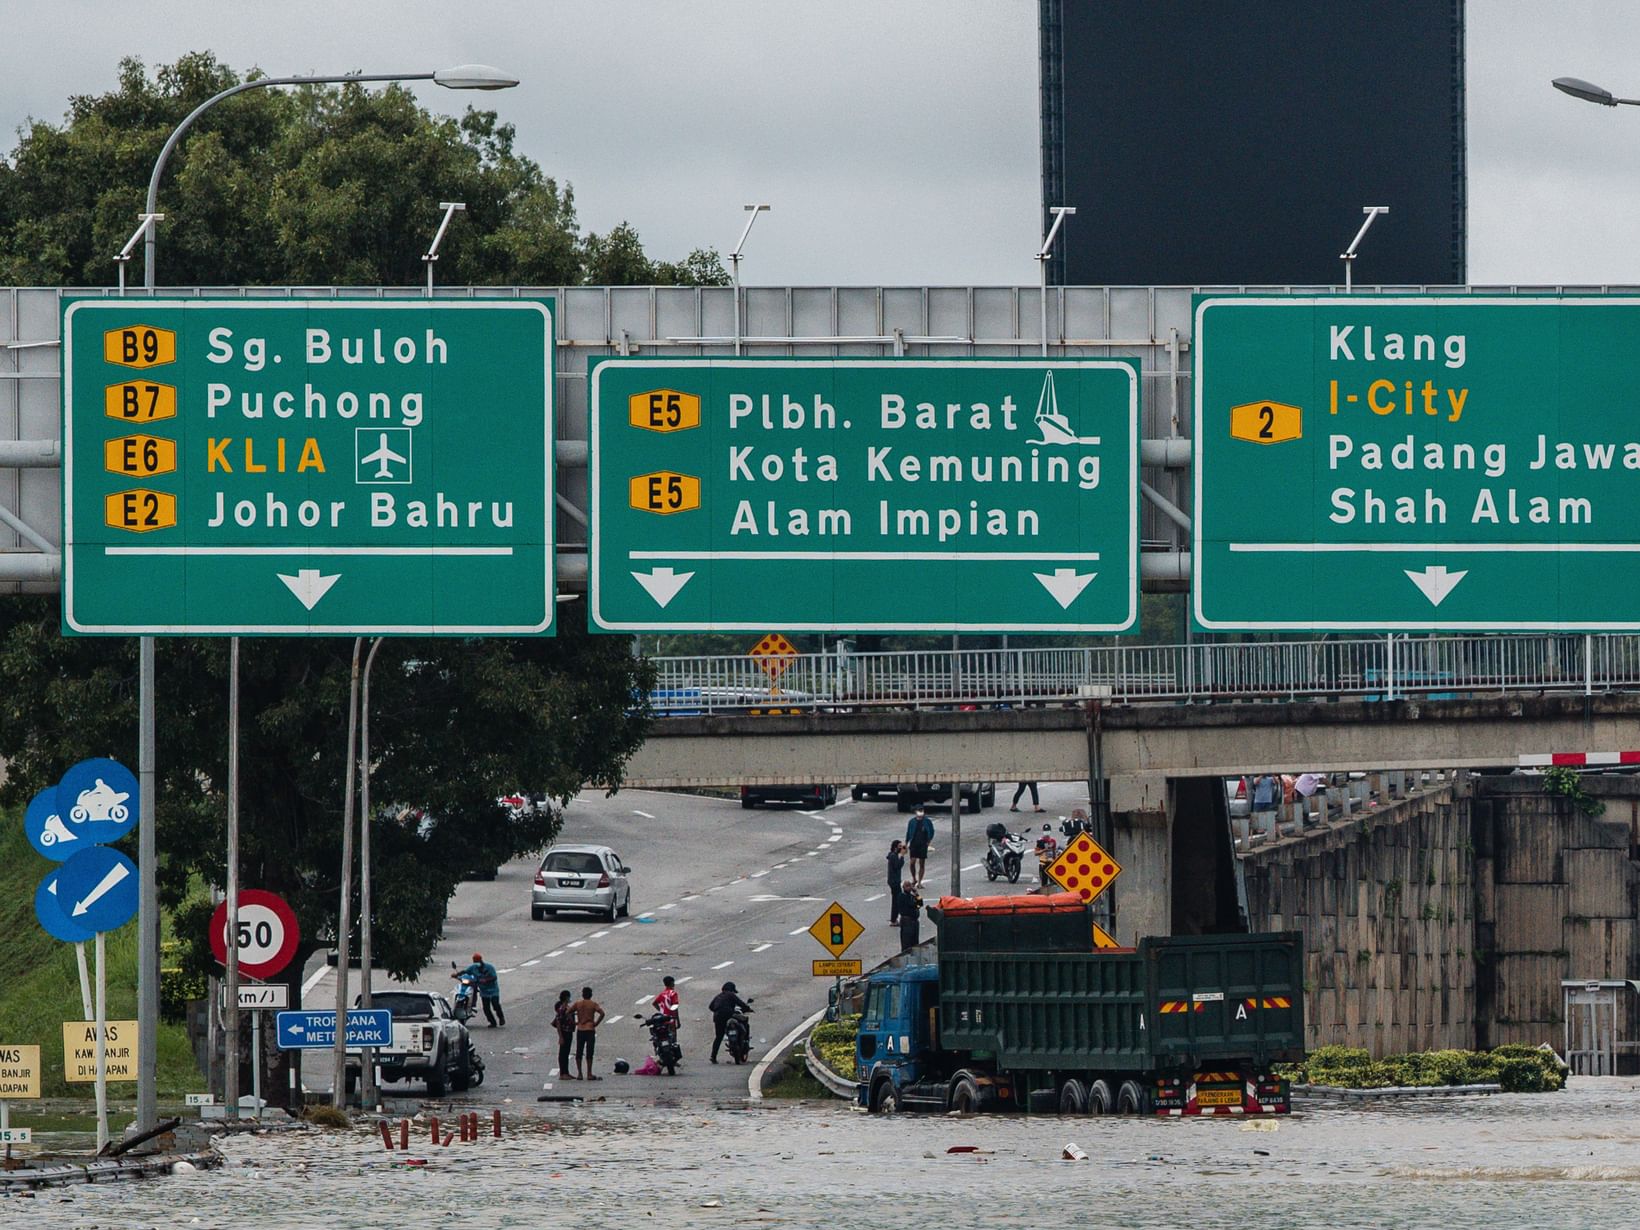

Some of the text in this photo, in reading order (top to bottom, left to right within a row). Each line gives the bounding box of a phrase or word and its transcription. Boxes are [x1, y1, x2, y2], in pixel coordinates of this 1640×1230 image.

[122, 330, 159, 363] B9
[206, 327, 449, 370] Sg. Buloh
[1329, 325, 1467, 368] Klang
[122, 386, 160, 418] B7
[207, 383, 424, 426] Puchong
[649, 394, 682, 428] E5
[729, 394, 1018, 430] Plbh. Barat
[1329, 379, 1469, 422] I-City
[1258, 406, 1274, 439] 2
[122, 440, 159, 471] E6
[207, 437, 326, 473] KLIA
[729, 447, 1101, 489] Kota Kemuning
[1329, 435, 1507, 477] Padang
[207, 492, 514, 528] Johor Bahru
[648, 476, 683, 510] E5
[1328, 488, 1593, 524] Shah Alam
[122, 494, 160, 527] E2
[730, 500, 1040, 542] Alam Impian
[237, 921, 272, 949] 50
[1139, 1013, 1146, 1030] A
[1236, 1003, 1247, 1020] A
[104, 1048, 130, 1059] ANJIR
[887, 1035, 894, 1051] A
[1, 1069, 31, 1078] BANJIR
[78, 1065, 87, 1076] DI
